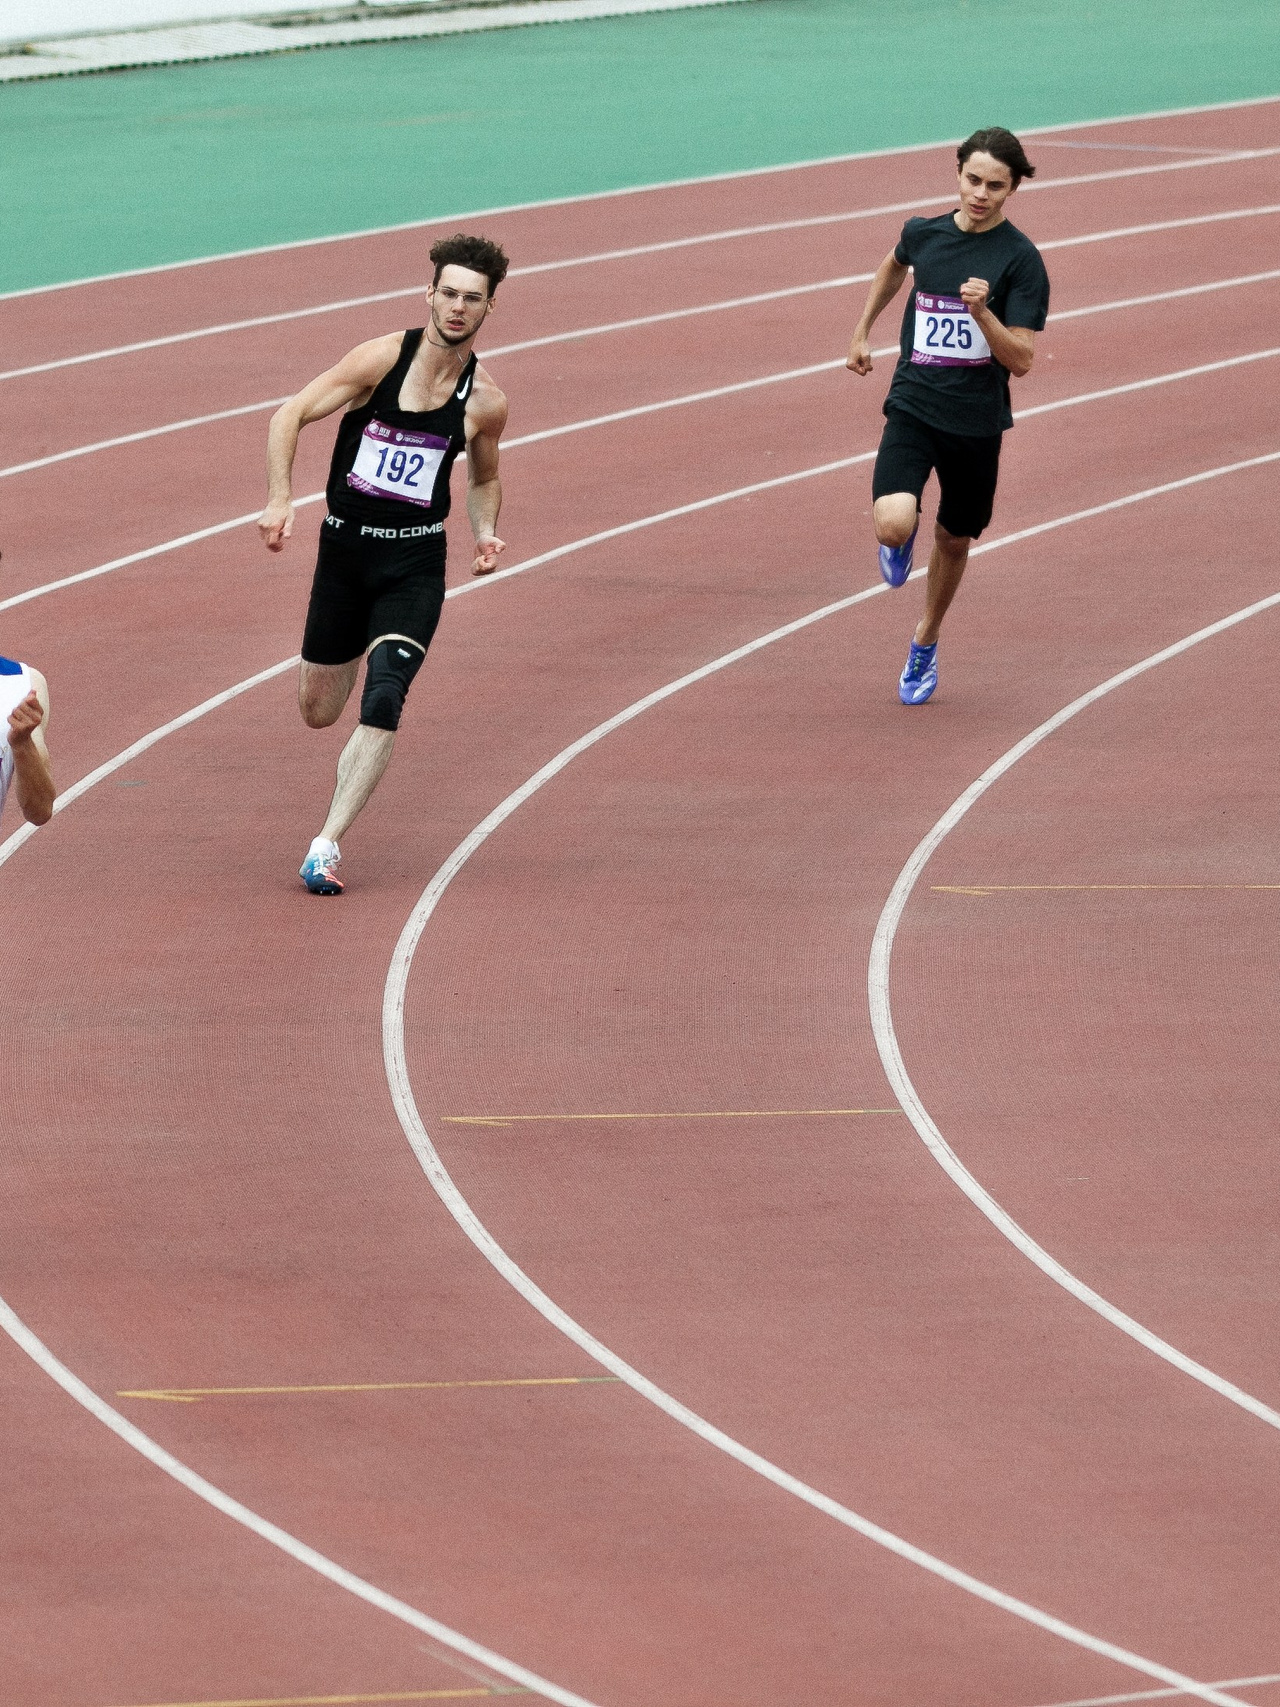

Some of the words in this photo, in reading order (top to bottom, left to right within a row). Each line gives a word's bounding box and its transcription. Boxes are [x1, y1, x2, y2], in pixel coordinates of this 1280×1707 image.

[926, 316, 972, 350] 225
[375, 447, 425, 488] 192
[326, 515, 345, 529] AT
[360, 525, 397, 539] PRO
